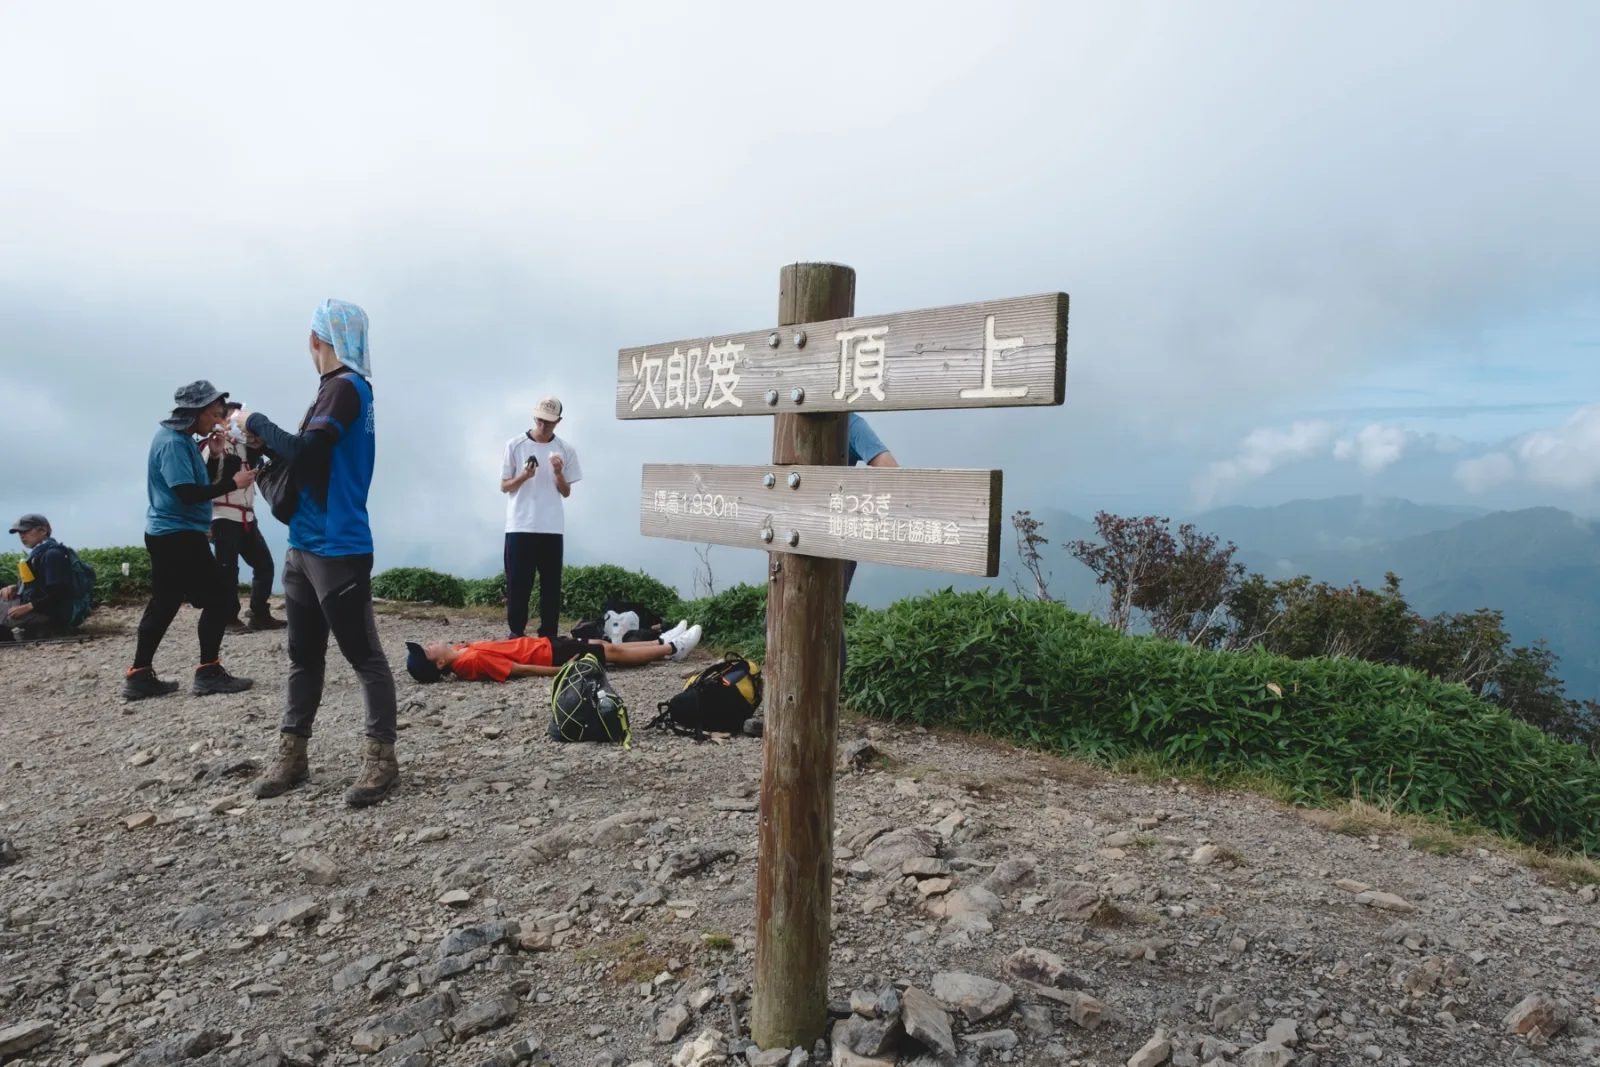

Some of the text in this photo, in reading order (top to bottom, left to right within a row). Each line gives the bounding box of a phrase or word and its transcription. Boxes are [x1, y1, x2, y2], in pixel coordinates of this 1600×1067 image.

[628, 341, 745, 411] 次郎笈
[829, 493, 892, 517] 南つるぎ
[828, 516, 960, 545] 地域活性化協議会
